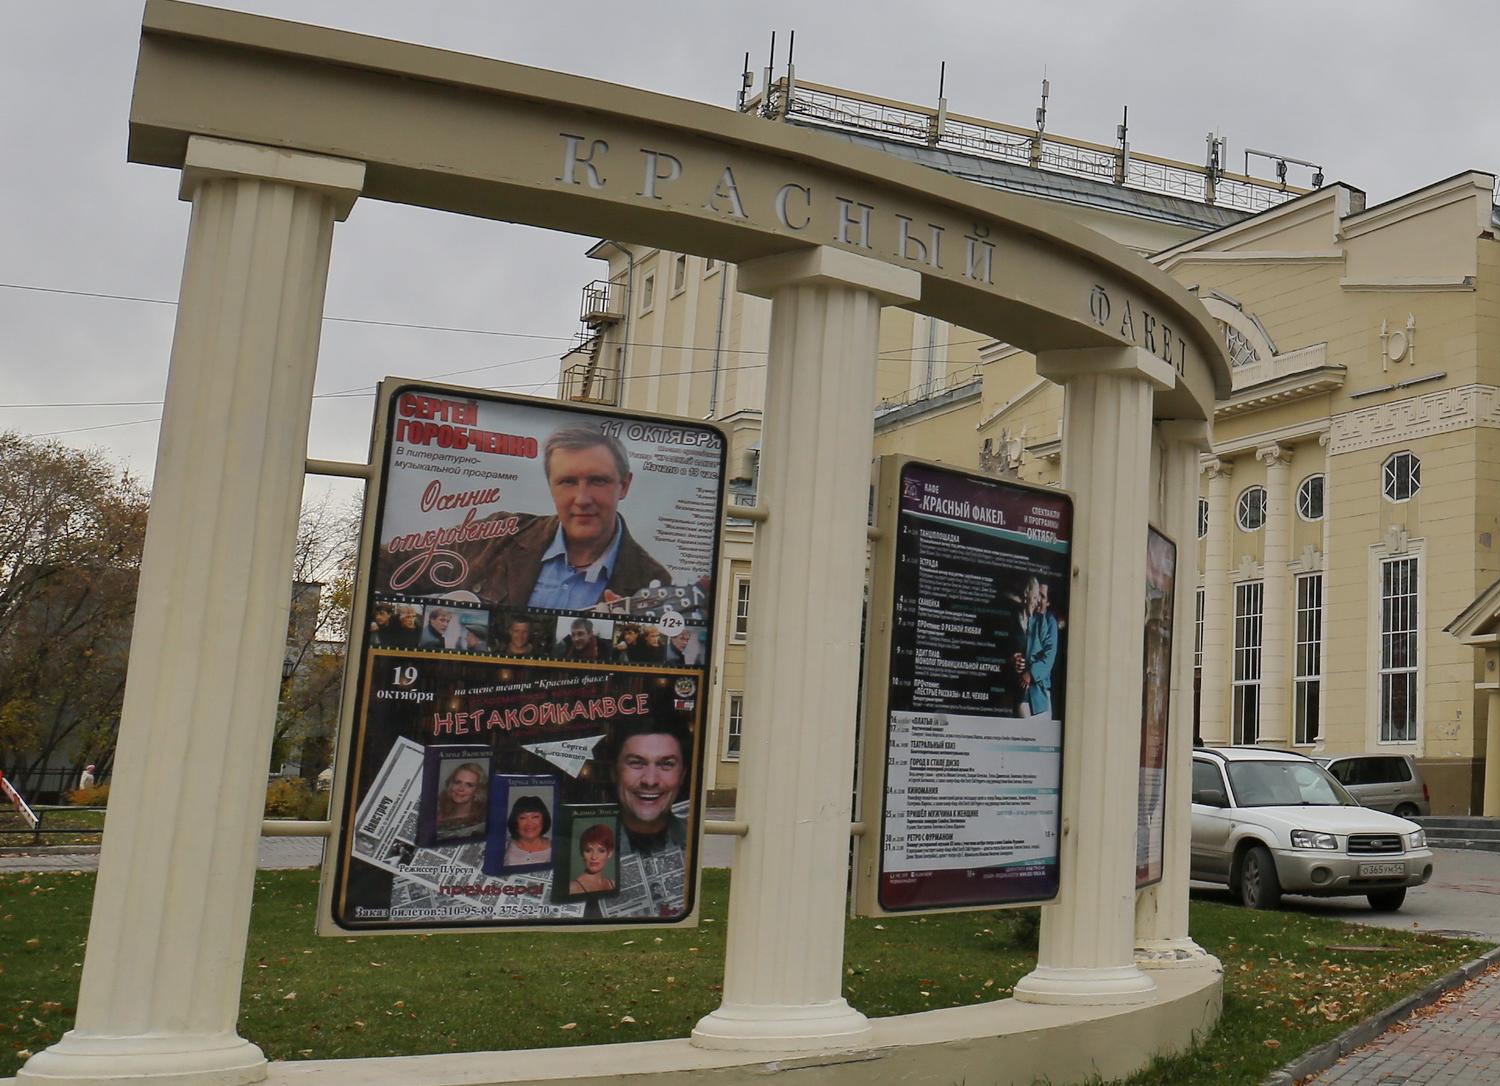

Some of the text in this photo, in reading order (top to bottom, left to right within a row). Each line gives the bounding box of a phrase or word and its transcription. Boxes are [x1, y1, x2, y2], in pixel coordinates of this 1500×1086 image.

[554, 133, 1186, 378] КРАСНЫЙ ФАКЕЛ
[399, 392, 480, 427] СЕРГЕЙ
[396, 418, 538, 459] ГОРОБЧЕНКО
[600, 420, 721, 449] 11 ОКТЯБРЯ
[396, 446, 481, 464] В литературно-
[394, 461, 518, 481] музыкальной программе
[643, 461, 678, 474] Начало
[420, 479, 501, 513] Осенние
[924, 483, 940, 494] КАФЕ
[1031, 507, 1060, 519] СПЕКТАКЛИ
[1029, 515, 1060, 529] ПРОГРАММЫ
[1026, 527, 1057, 545] ОКТЯБРЬ
[919, 557, 939, 568] ЭСТРАДА
[662, 618, 682, 628] 12+
[391, 666, 418, 686] 19
[376, 688, 434, 704] октября
[454, 688, 466, 696] на
[467, 686, 494, 696] сцене
[495, 682, 532, 694] театра
[433, 693, 649, 737] НЕТАКОЙКАКВСЕ
[561, 742, 587, 752] Сергей
[399, 864, 438, 875] Режиссер
[438, 883, 545, 897] премьера!
[355, 907, 388, 918] Заказ
[500, 905, 550, 916] 375-52-70
